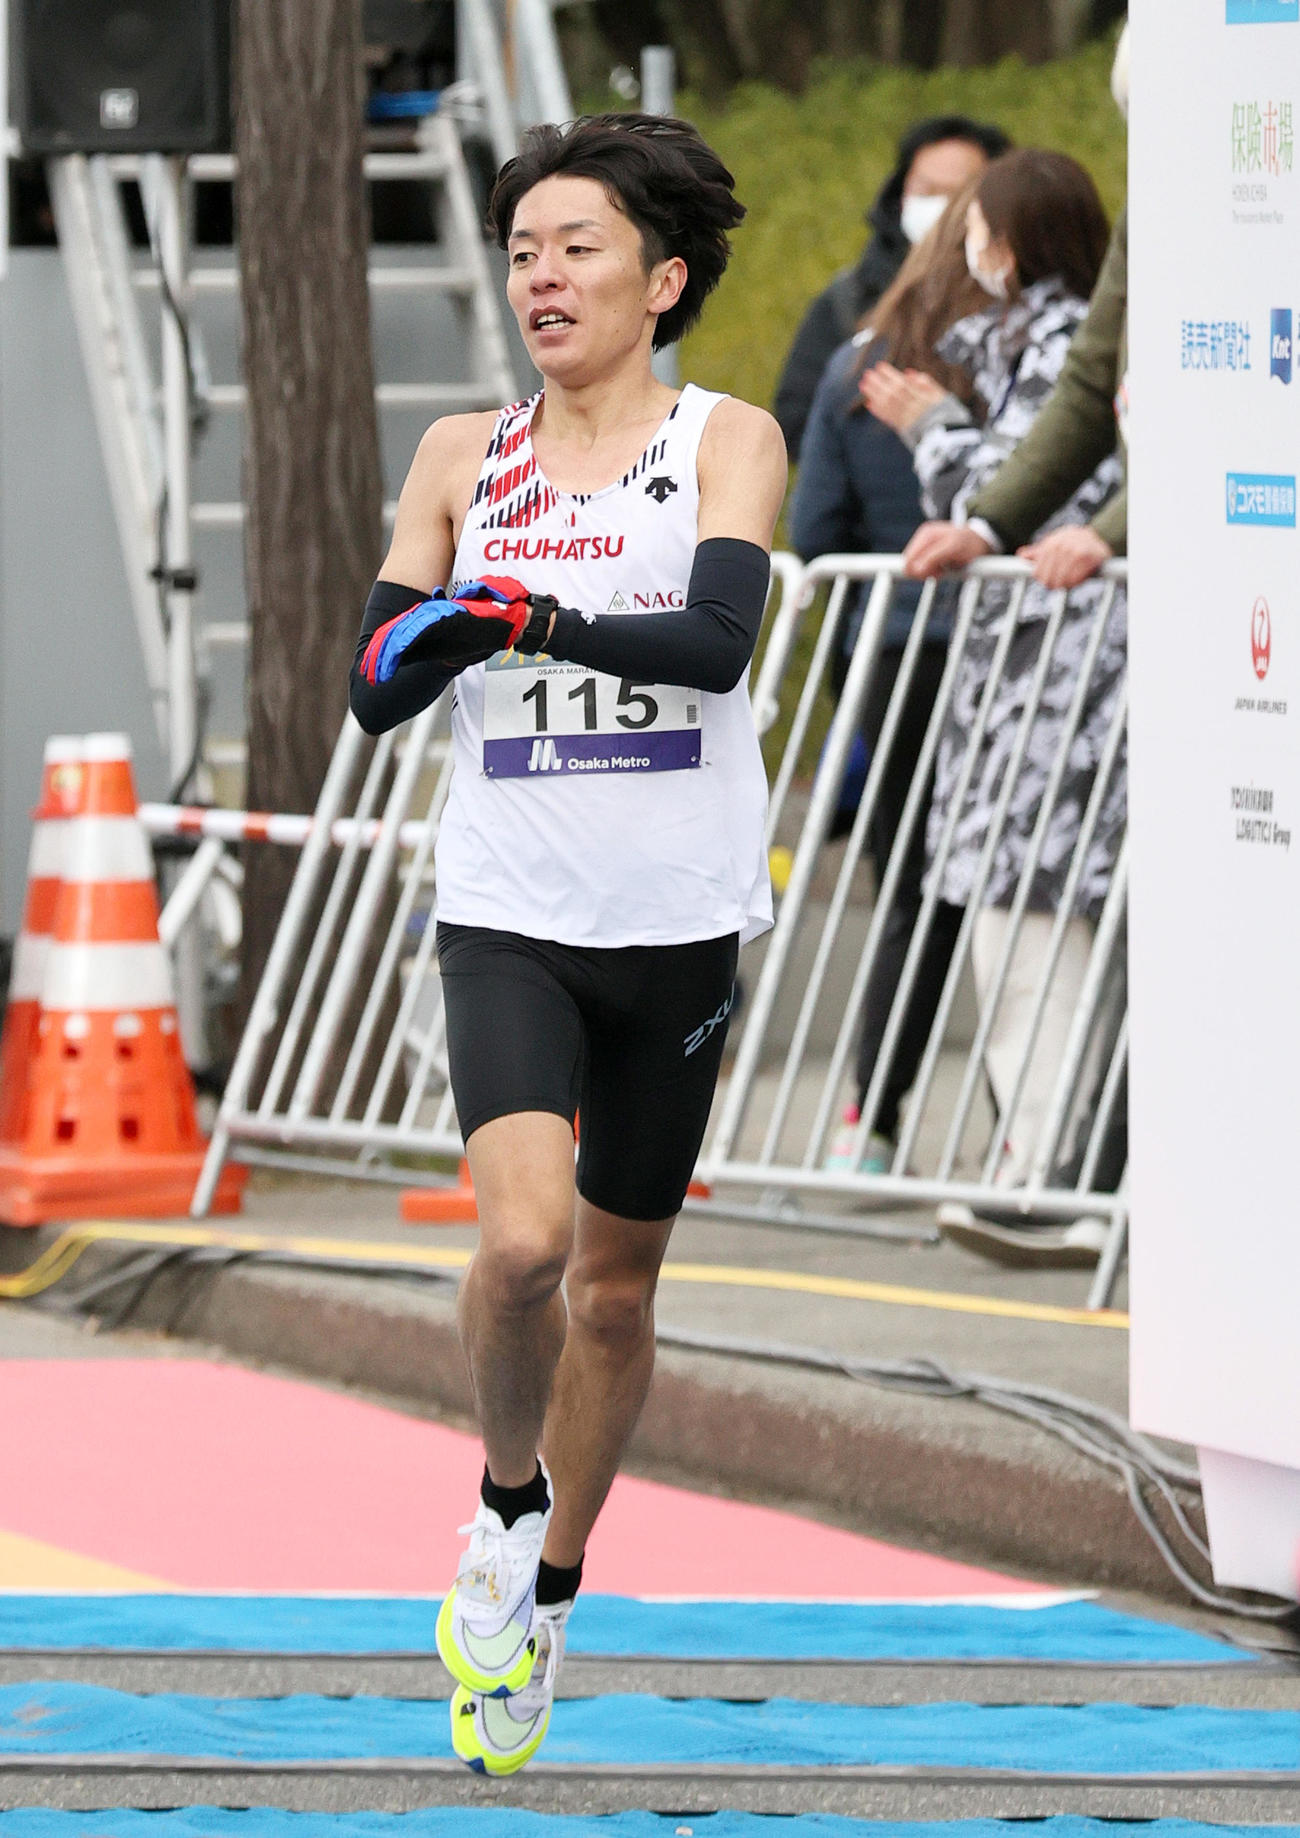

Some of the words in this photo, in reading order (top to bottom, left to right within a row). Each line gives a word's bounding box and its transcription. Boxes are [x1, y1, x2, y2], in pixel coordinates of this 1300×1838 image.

[1232, 100, 1294, 176] 保険市場
[483, 535, 625, 562] CHUHATSU
[537, 668, 565, 676] OSAKA
[522, 677, 659, 733] 115
[567, 758, 609, 771] Osaka
[610, 756, 651, 770] Metro
[683, 979, 736, 1057] 2XU
